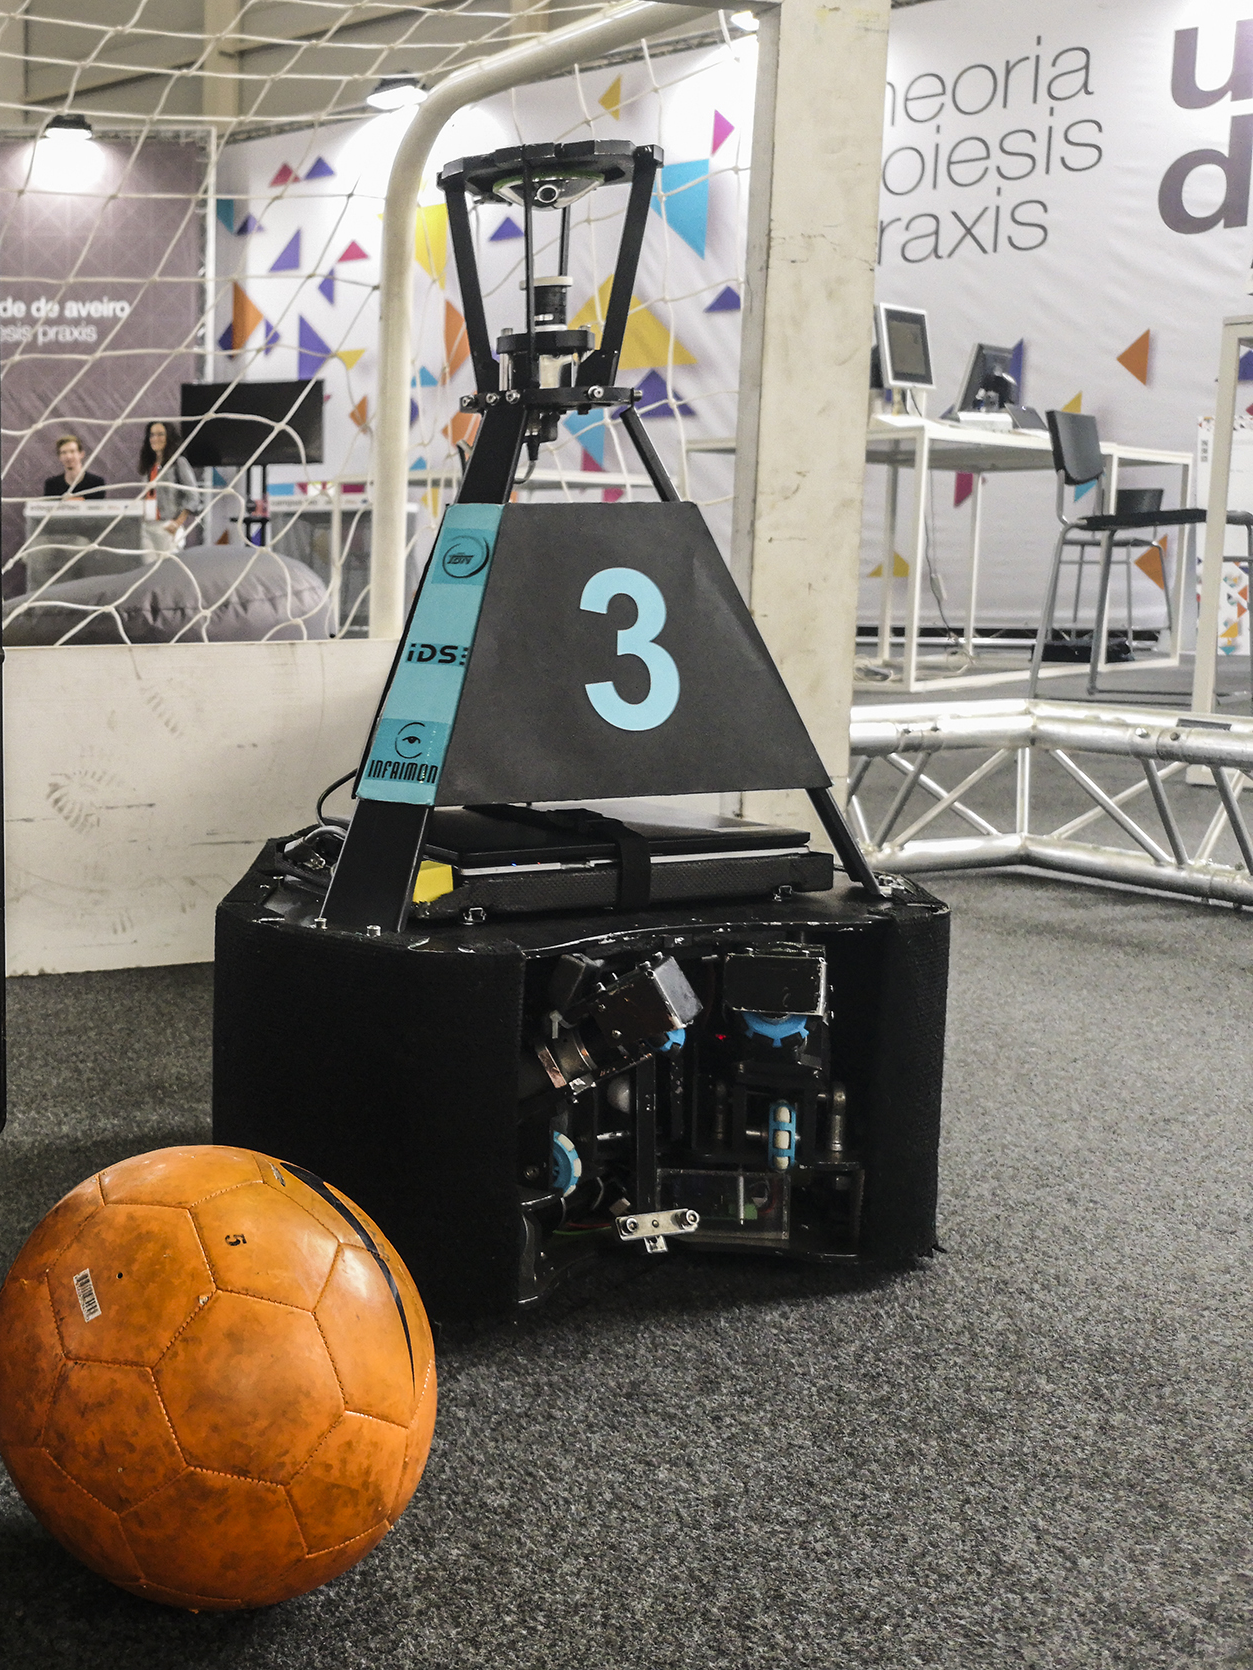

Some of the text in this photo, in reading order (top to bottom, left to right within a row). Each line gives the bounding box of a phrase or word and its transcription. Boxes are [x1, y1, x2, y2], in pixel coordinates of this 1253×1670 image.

[30, 295, 60, 319] de
[64, 295, 130, 319] aveiro
[37, 319, 98, 346] praxis
[580, 566, 681, 732] 3
[367, 759, 439, 784] INFAIMON
